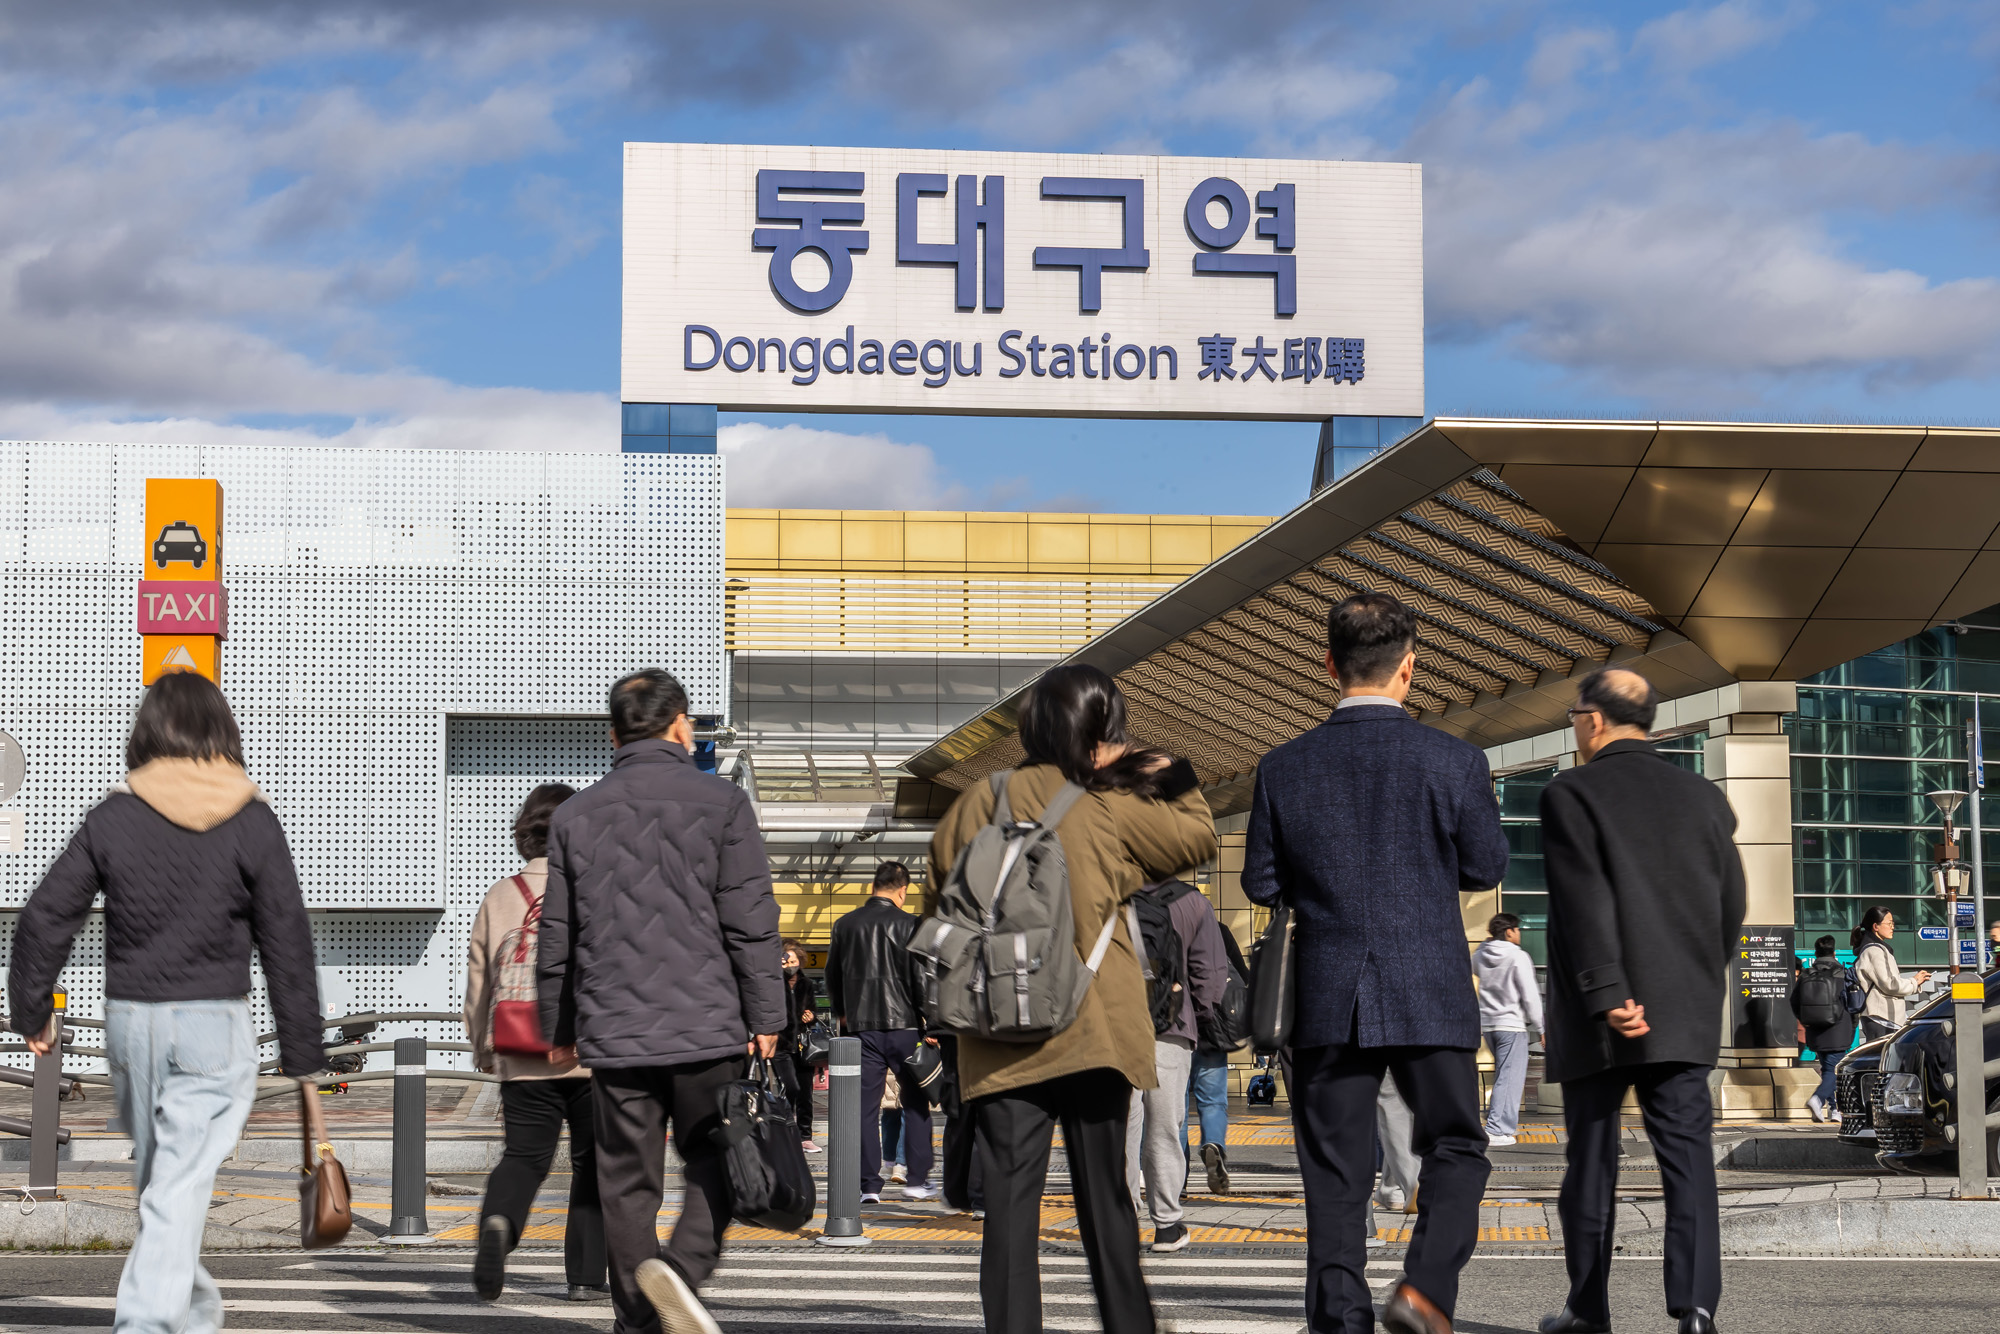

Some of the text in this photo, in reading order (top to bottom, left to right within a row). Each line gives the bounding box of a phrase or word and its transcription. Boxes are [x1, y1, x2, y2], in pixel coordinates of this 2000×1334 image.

[752, 168, 1297, 317] 동대구역
[683, 324, 1366, 388] Dongdaegu Station 東大邱驛
[142, 592, 216, 622] TAXI
[810, 954, 817, 966] 3
